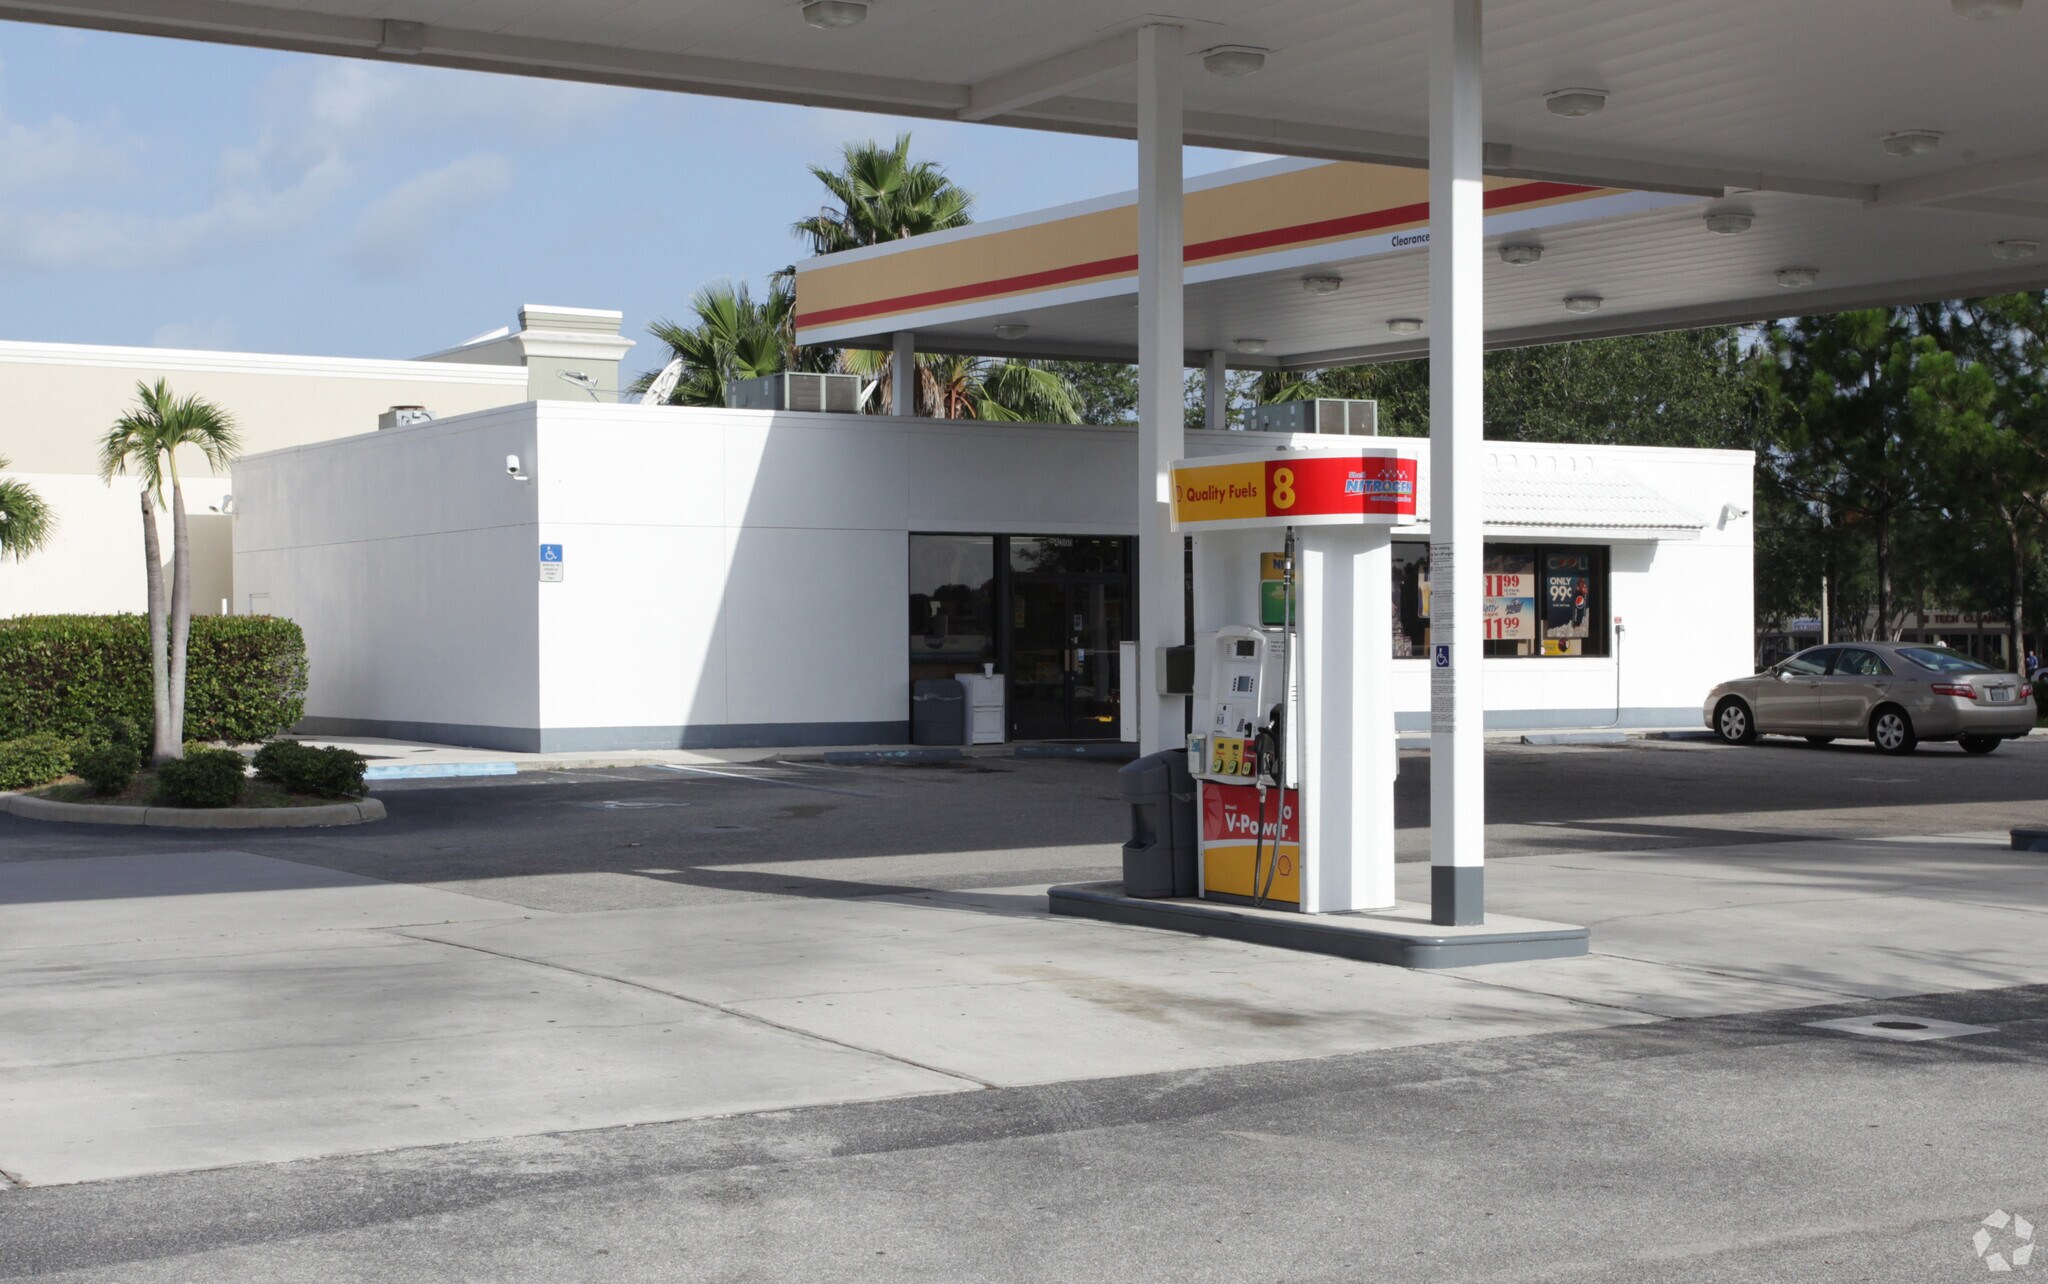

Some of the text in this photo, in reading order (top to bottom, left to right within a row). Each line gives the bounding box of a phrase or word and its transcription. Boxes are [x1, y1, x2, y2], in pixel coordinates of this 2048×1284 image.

[1391, 233, 1430, 247] Clearance
[1187, 482, 1257, 504] Quality Fuels
[1272, 467, 1296, 510] 8
[1345, 479, 1412, 494] NITROGEN
[1550, 577, 1571, 585] ONLY
[1934, 614, 1959, 624] TECH
[1224, 803, 1237, 811] Shell
